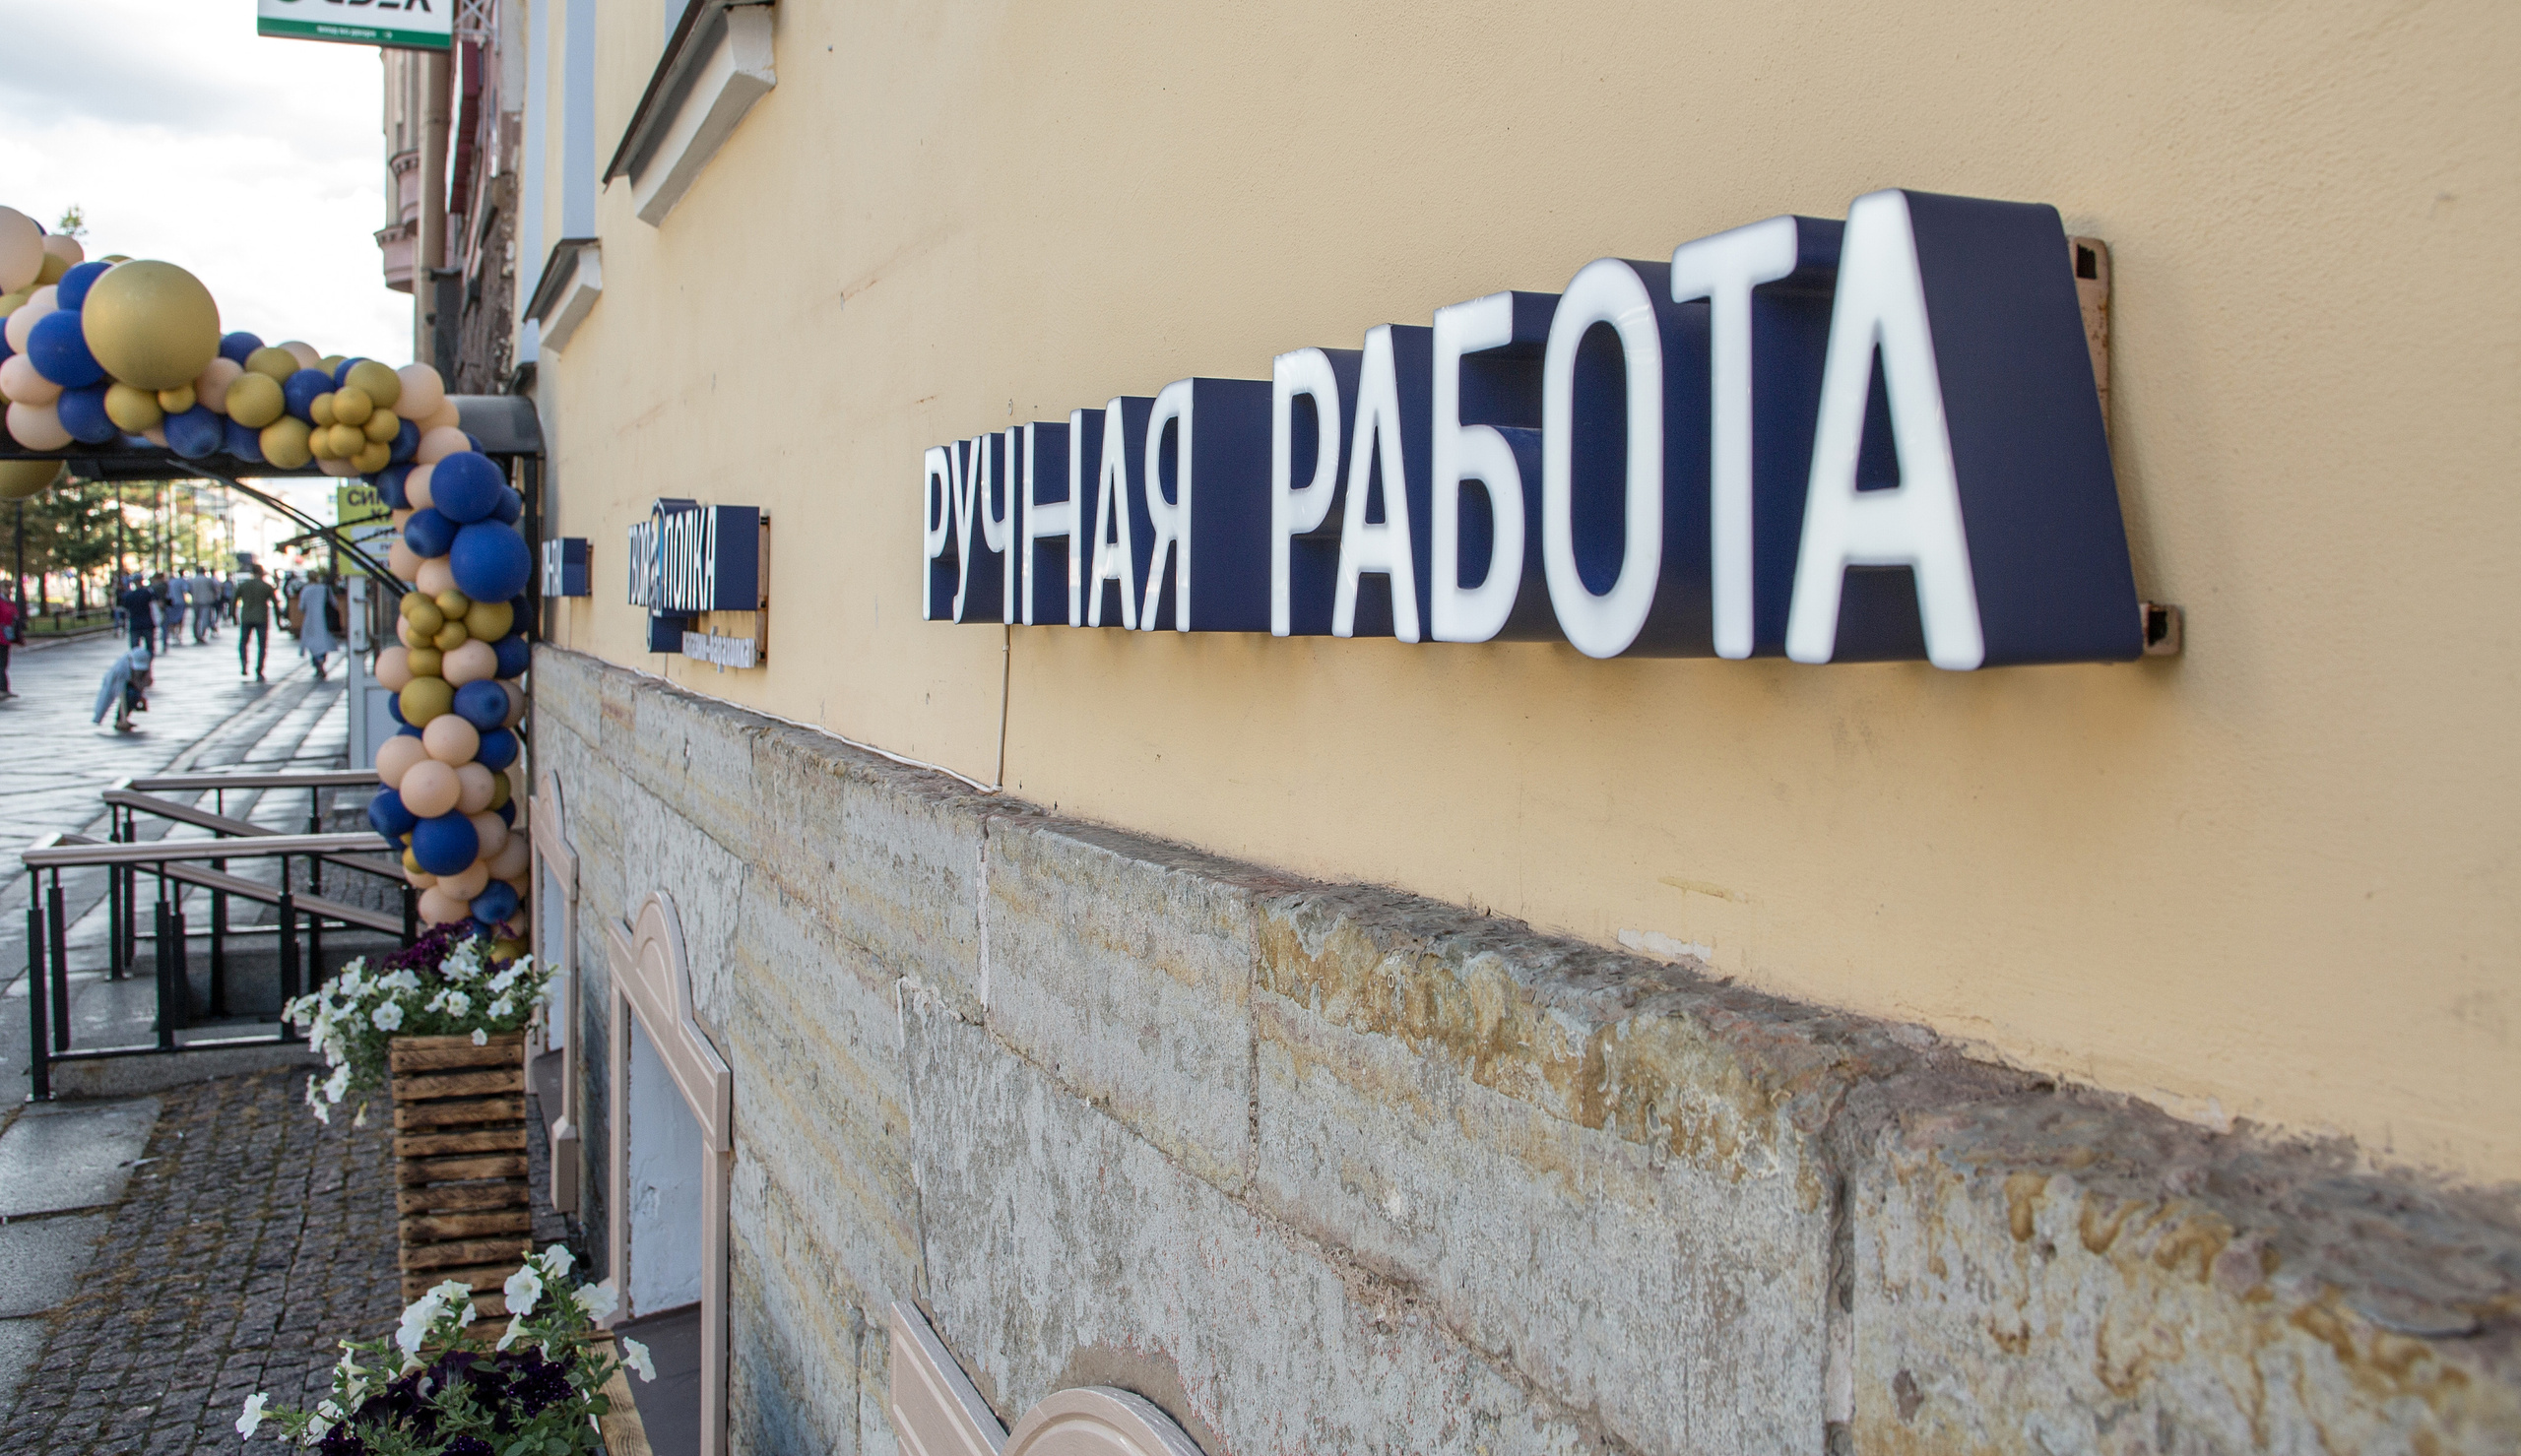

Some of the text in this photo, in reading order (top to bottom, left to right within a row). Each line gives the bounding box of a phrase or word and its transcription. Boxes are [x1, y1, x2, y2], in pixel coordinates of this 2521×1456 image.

[628, 520, 651, 607] ТВОЯ
[664, 505, 717, 612] ПОЛКА
[923, 189, 1985, 670] РУЧНАЯ РАБОТА
